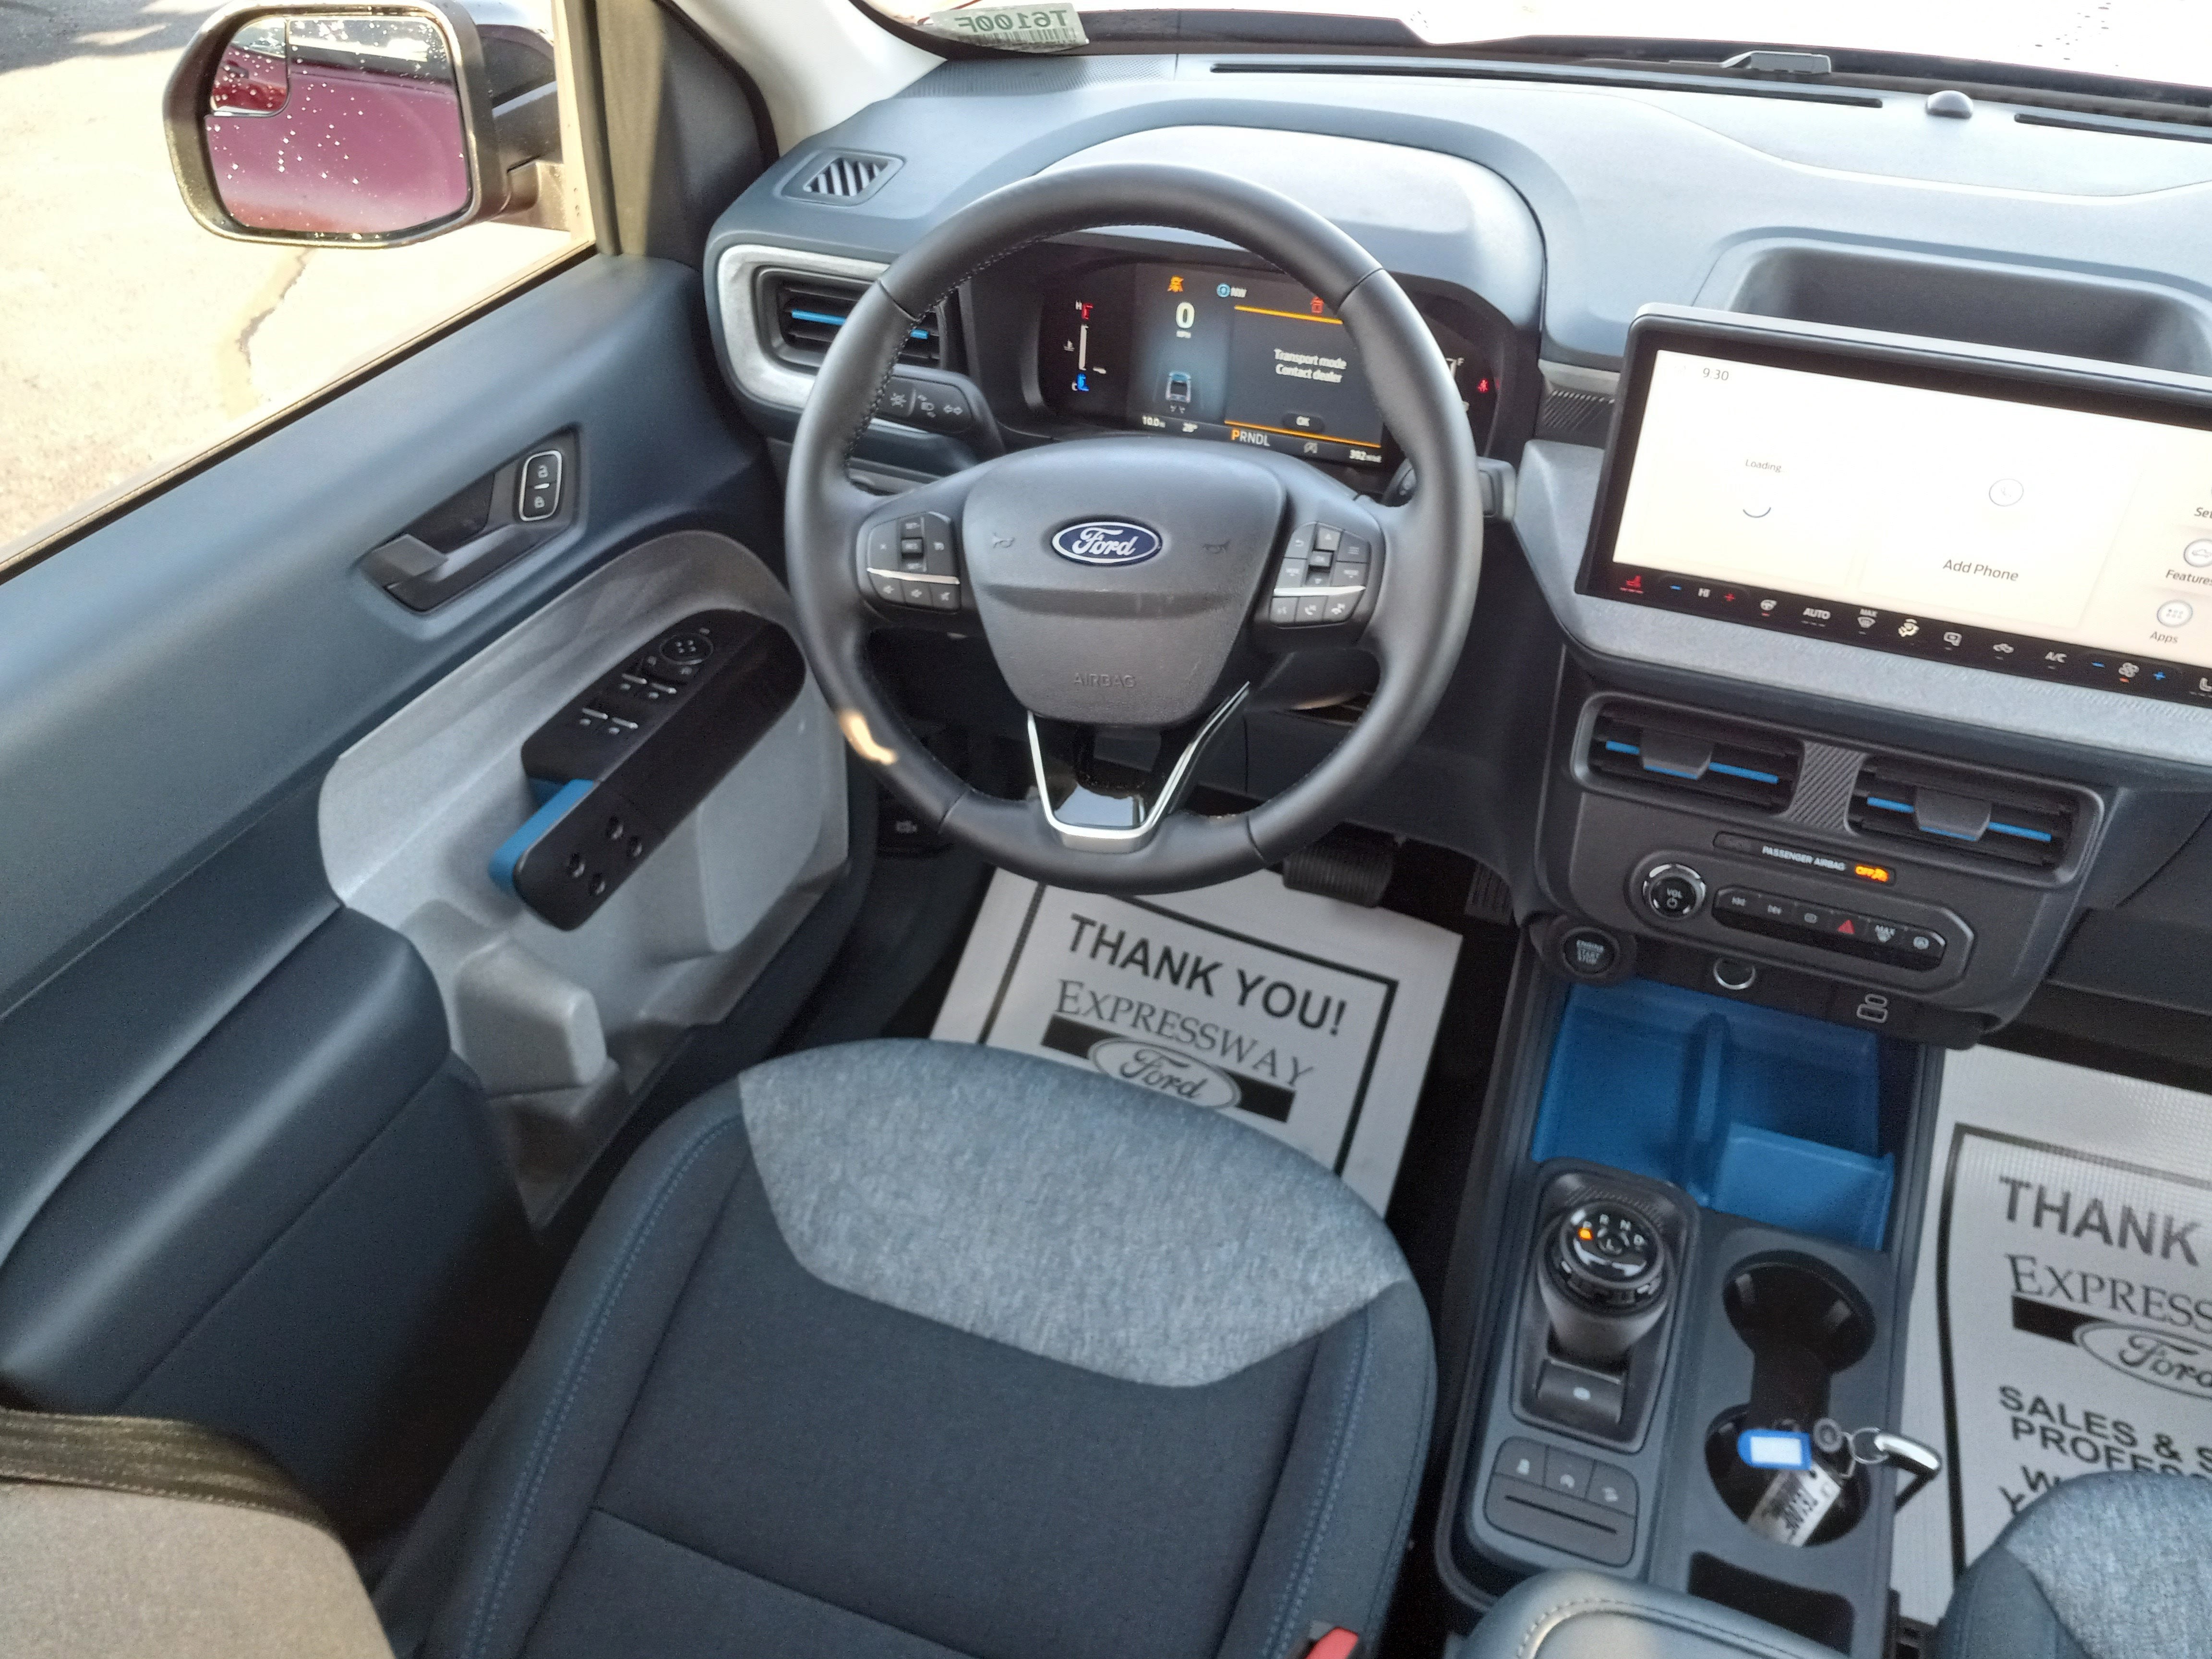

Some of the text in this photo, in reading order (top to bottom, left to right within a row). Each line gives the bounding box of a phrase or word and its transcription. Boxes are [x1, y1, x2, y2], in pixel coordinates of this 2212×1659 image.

[1176, 302, 1195, 328] 0
[1274, 348, 1347, 369] Transport mode
[1275, 363, 1343, 383] Contact dealer
[1231, 428, 1270, 446] PRNDL
[1072, 527, 1139, 556] Ford
[1943, 559, 2020, 581] Add Phone
[1803, 608, 1831, 620] AUTO
[2150, 631, 2178, 645] Apps
[2045, 651, 2068, 663] A/C
[1074, 673, 1137, 688] AIRBAG
[1762, 845, 1813, 864] PASSENGER
[1814, 857, 1846, 871] AIRBAG
[1070, 914, 1347, 1035] THANK YOU!
[1056, 979, 1314, 1086] EXPRESSWAY
[1119, 1049, 1208, 1100] Ford
[2000, 1176, 2200, 1266] THANK
[1999, 1385, 2138, 1447] SALES
[2154, 1433, 2183, 1463] &
